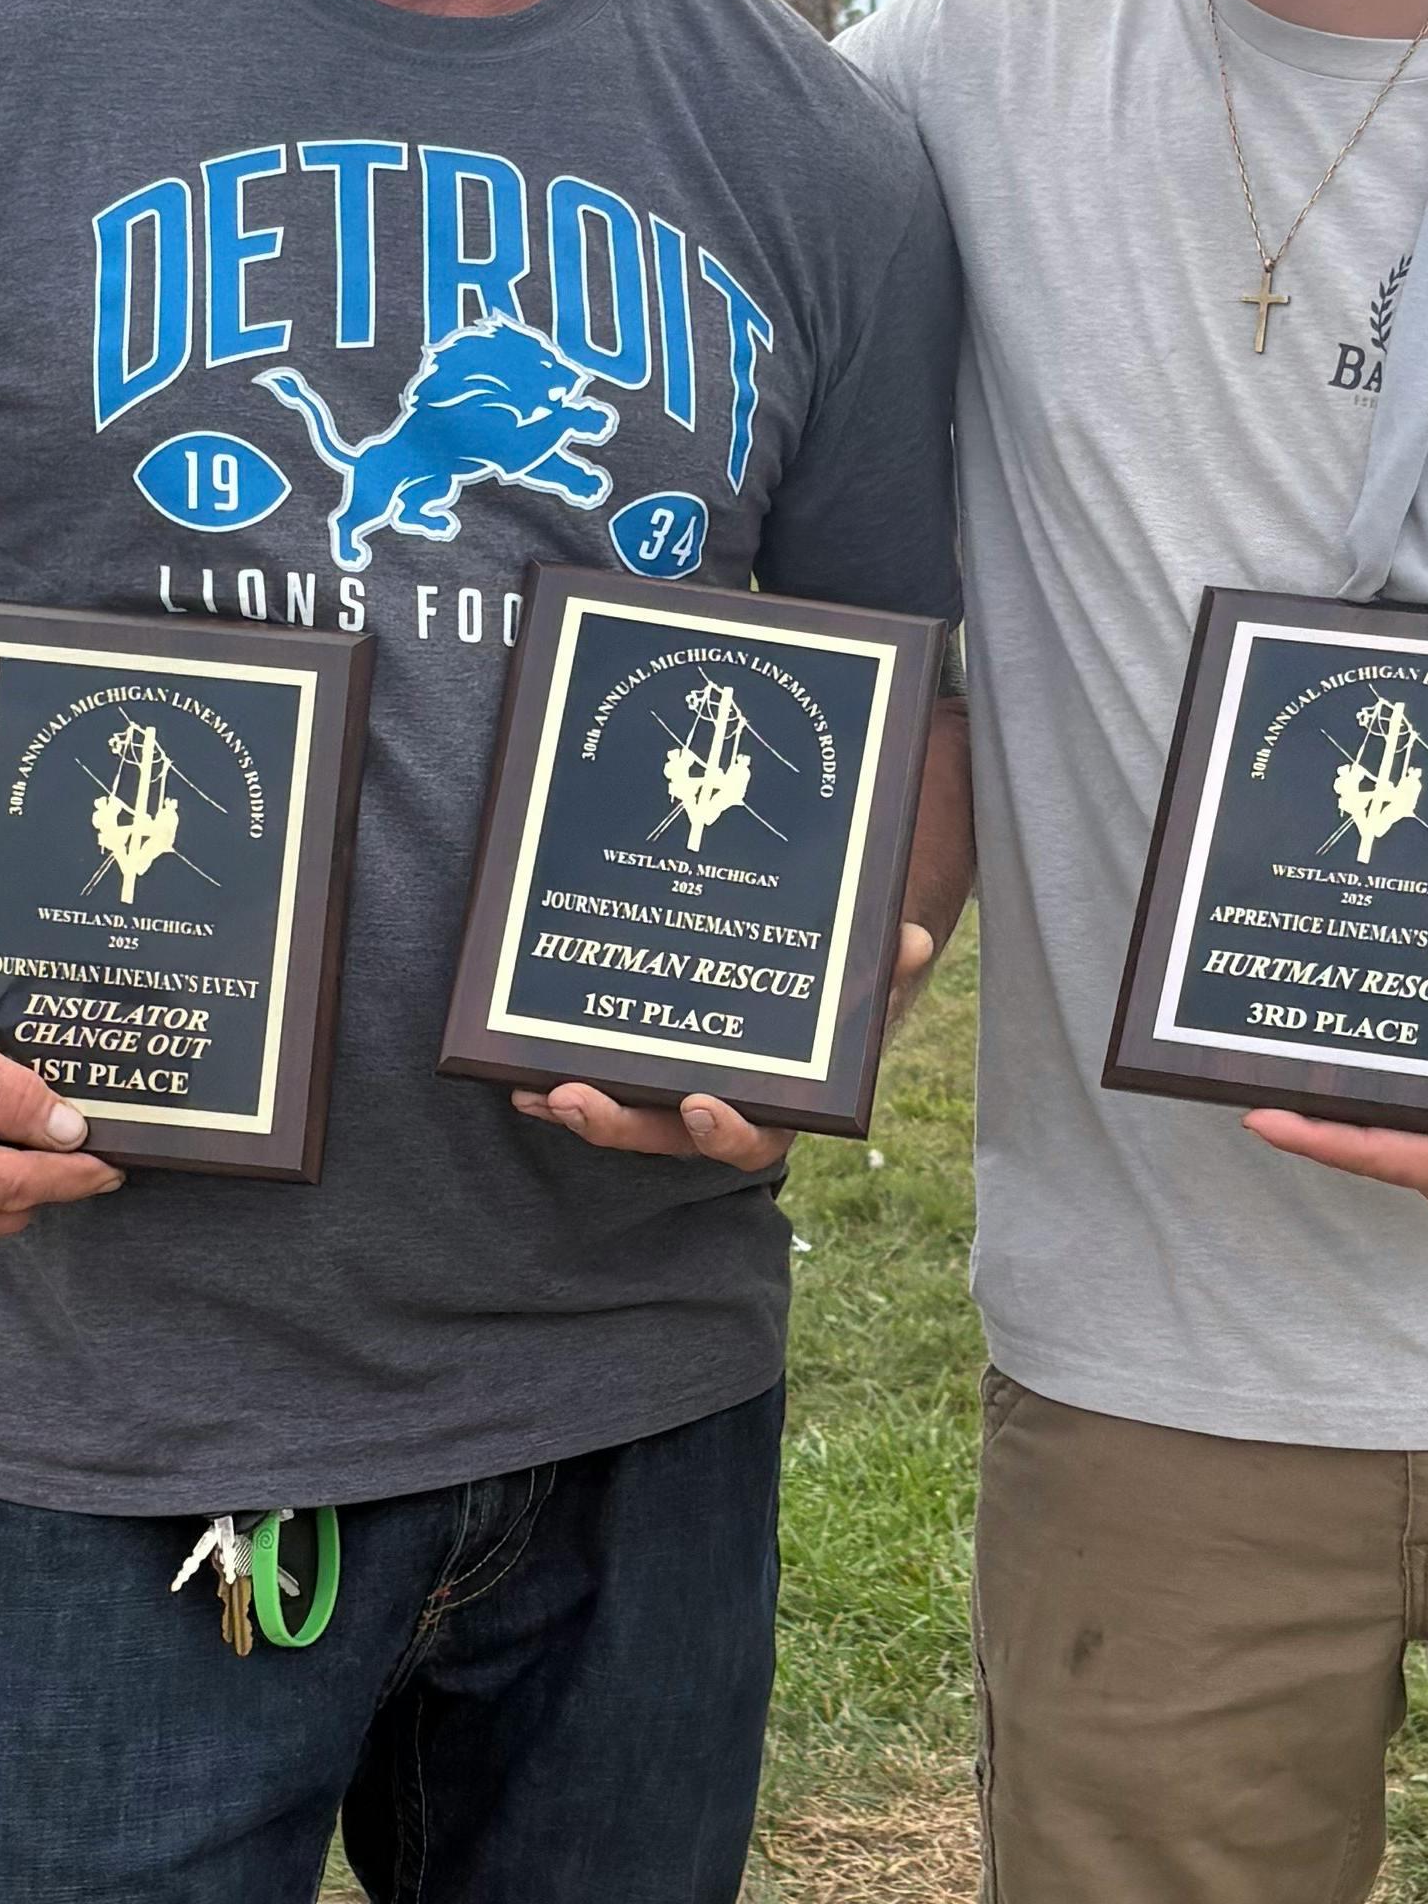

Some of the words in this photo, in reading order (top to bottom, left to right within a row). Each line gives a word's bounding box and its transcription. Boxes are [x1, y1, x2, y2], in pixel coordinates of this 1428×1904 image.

[93, 140, 774, 495] DETROIT
[183, 450, 240, 512] 19
[638, 506, 697, 568] 34
[159, 565, 366, 632] LIONS
[581, 728, 602, 761] 30th
[594, 668, 651, 727] ANNUAL
[649, 647, 749, 674] MICHIGAN
[750, 655, 829, 732] LINEMAN'S
[818, 734, 837, 799] RODEO
[1250, 748, 1272, 781] 30th
[1263, 688, 1322, 747] ANNUAL
[1319, 665, 1421, 693] MICHIGAN
[8, 780, 27, 816] 30th
[18, 712, 72, 779] ANNUAL
[69, 685, 170, 718] MICHIGAN
[171, 691, 254, 769] LINEMAN'S
[243, 770, 265, 839] RODEO
[671, 879, 704, 896] 2025
[695, 863, 781, 888] MICHIGAN
[541, 889, 663, 924] JOURNEYMAN
[664, 909, 761, 941] LINEMAN'S
[762, 924, 822, 950] EVENT
[1340, 891, 1373, 907] 2025
[107, 935, 140, 950] 2025
[130, 916, 216, 938] MICHIGAN
[1209, 905, 1325, 935] APPRENTICE
[1326, 918, 1428, 948] LINEMAN'S
[103, 966, 199, 993] LINEMAN'S
[201, 975, 260, 999] EVENT
[530, 932, 692, 979] HURTMAN
[689, 957, 816, 1000] RESCUE
[1201, 949, 1361, 990] HURTMAN
[22, 993, 210, 1033] INSULATOR
[582, 992, 637, 1021] 1ST
[639, 1001, 745, 1039] PLACE
[1246, 1002, 1308, 1029] 3RD
[1312, 1010, 1419, 1045] PLACE
[14, 1020, 142, 1053] CHANGE
[146, 1033, 213, 1060] OUT
[29, 1057, 82, 1084] 1ST
[87, 1062, 189, 1095] PLACE
